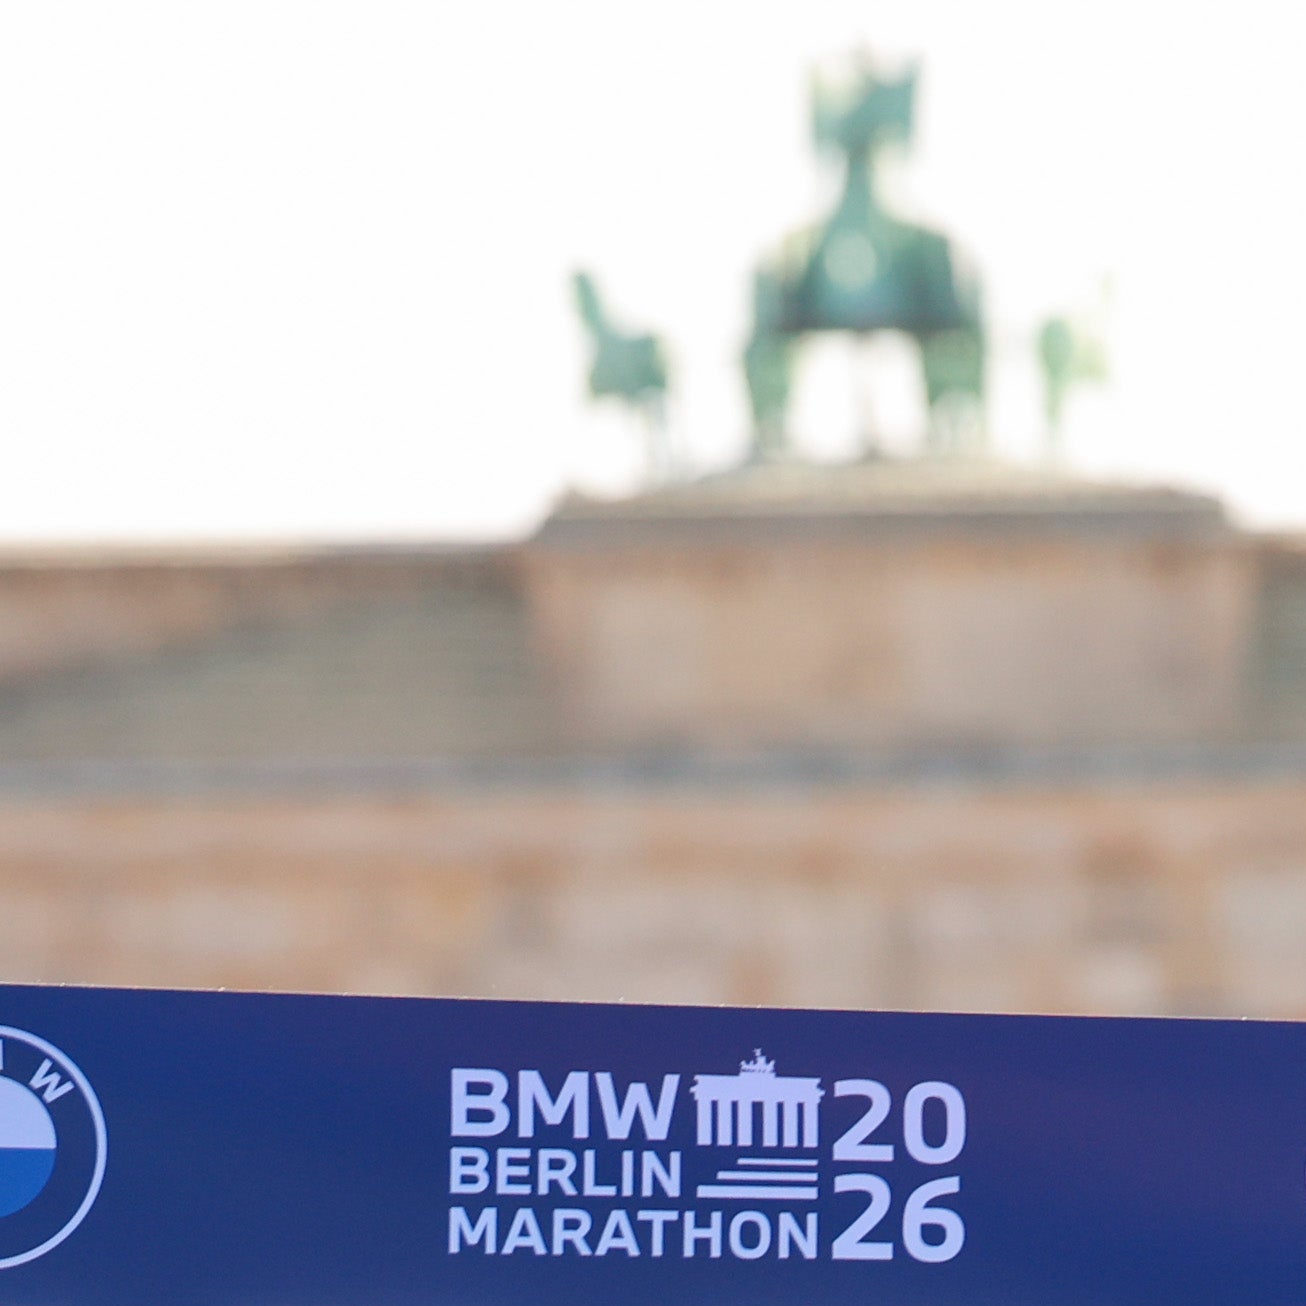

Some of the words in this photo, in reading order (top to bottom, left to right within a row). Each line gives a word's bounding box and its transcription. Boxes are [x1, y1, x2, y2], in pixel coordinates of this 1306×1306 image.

[451, 1069, 679, 1140] BMW
[833, 1080, 966, 1164] 20
[450, 1147, 681, 1198] BERLIN
[449, 1207, 818, 1260] MARATHON
[832, 1174, 964, 1263] 26
